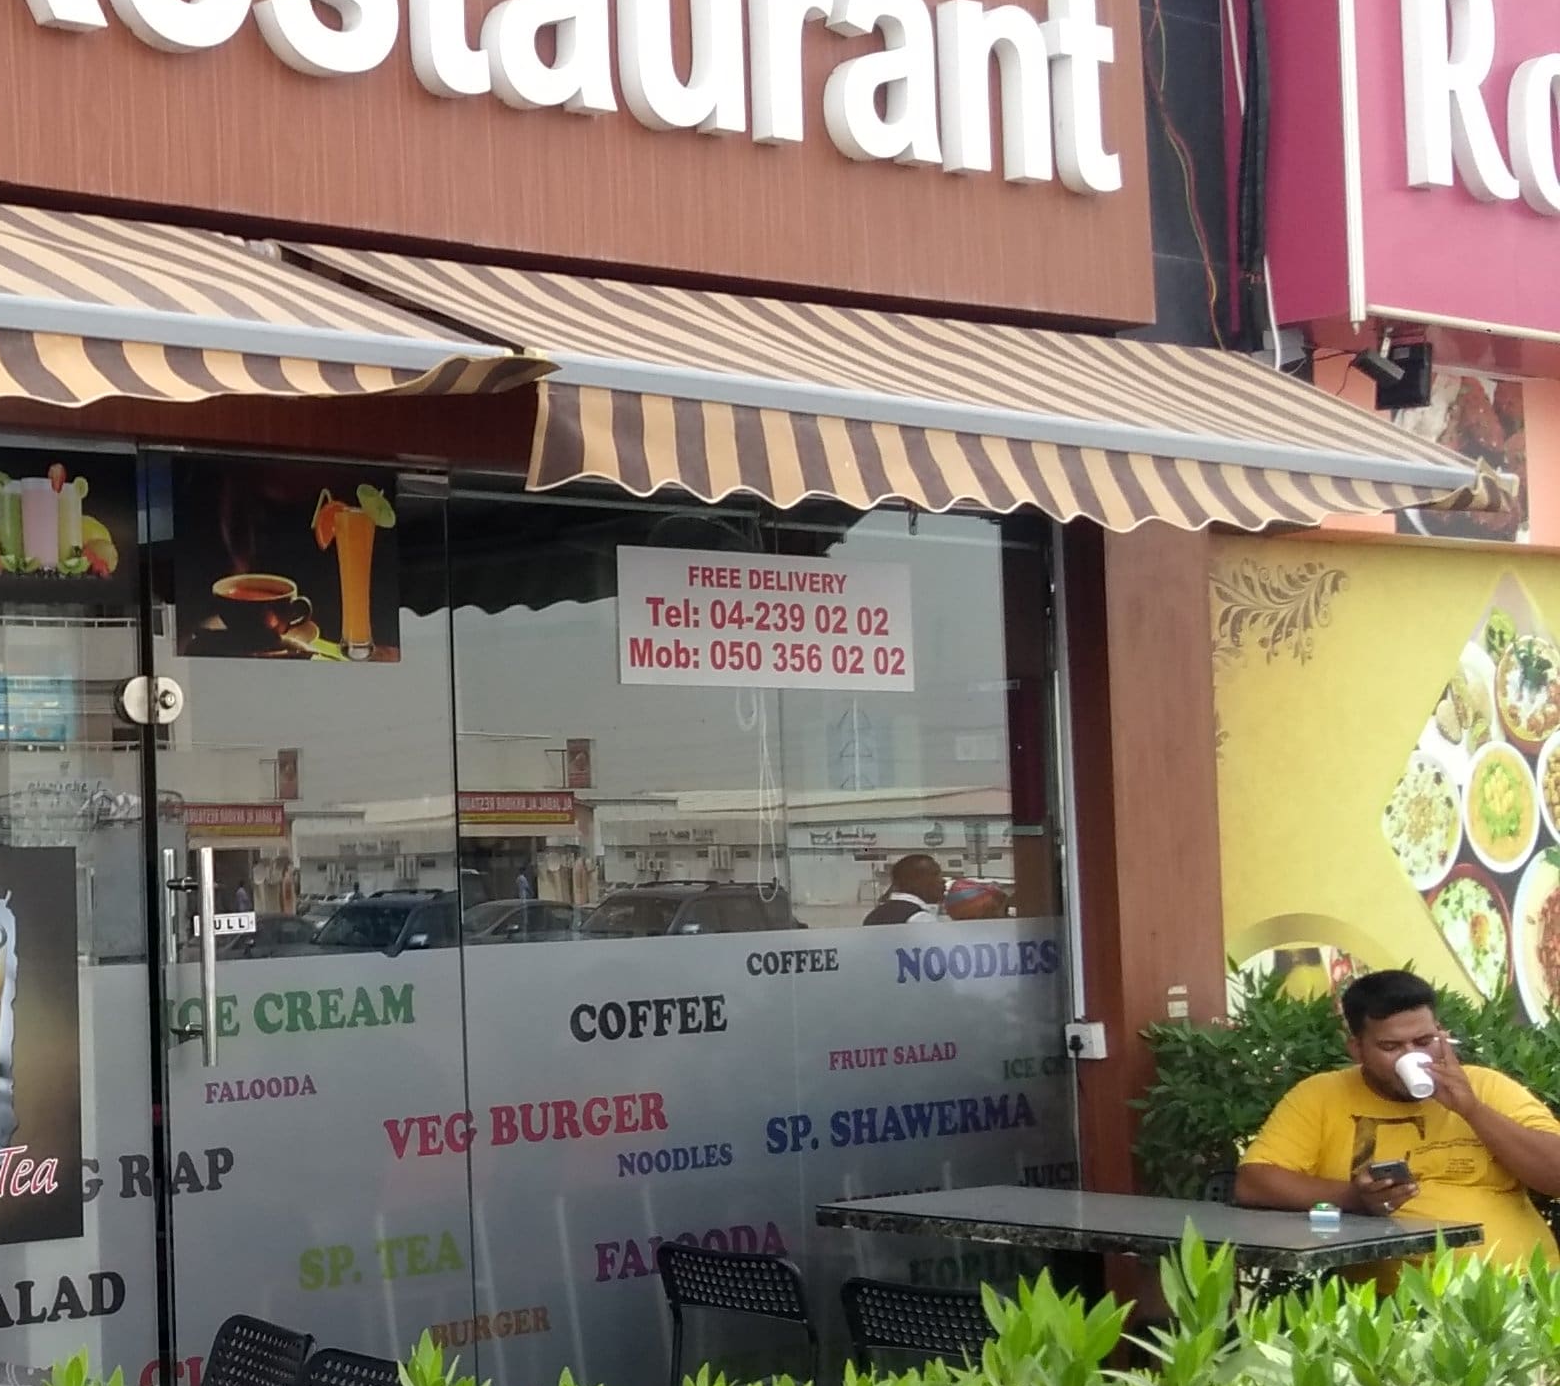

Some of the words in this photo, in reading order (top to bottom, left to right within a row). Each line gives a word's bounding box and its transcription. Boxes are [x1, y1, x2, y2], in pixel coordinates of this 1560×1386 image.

[688, 565, 742, 589] FREE
[748, 568, 848, 595] DELIVERY
[645, 596, 700, 628] Tel:
[709, 599, 806, 632] 04-239
[814, 604, 848, 634] 02
[856, 606, 889, 636] 02
[629, 637, 700, 669] Mob:
[709, 640, 762, 671] 050
[771, 642, 823, 674] 356
[831, 645, 865, 674] 02
[873, 646, 906, 676] 02
[213, 918, 245, 930] ULL
[746, 948, 839, 976] COFFEE
[896, 939, 1061, 984] NOODLES
[253, 983, 415, 1034] CREAM
[570, 994, 728, 1043] COFFEE
[828, 1046, 889, 1071] FRUIT
[893, 1042, 957, 1064] SALAD
[204, 1074, 318, 1104] FALOODA
[383, 1110, 478, 1160] VEG
[489, 1092, 669, 1146] BURGER
[766, 1114, 819, 1154] SP.
[829, 1092, 1038, 1148] SHAWERMA
[118, 1147, 235, 1199] RAP
[617, 1142, 734, 1178] NOODLES
[299, 1244, 363, 1292] SP.
[375, 1230, 466, 1281] TEA
[432, 1305, 552, 1350] BURGER
